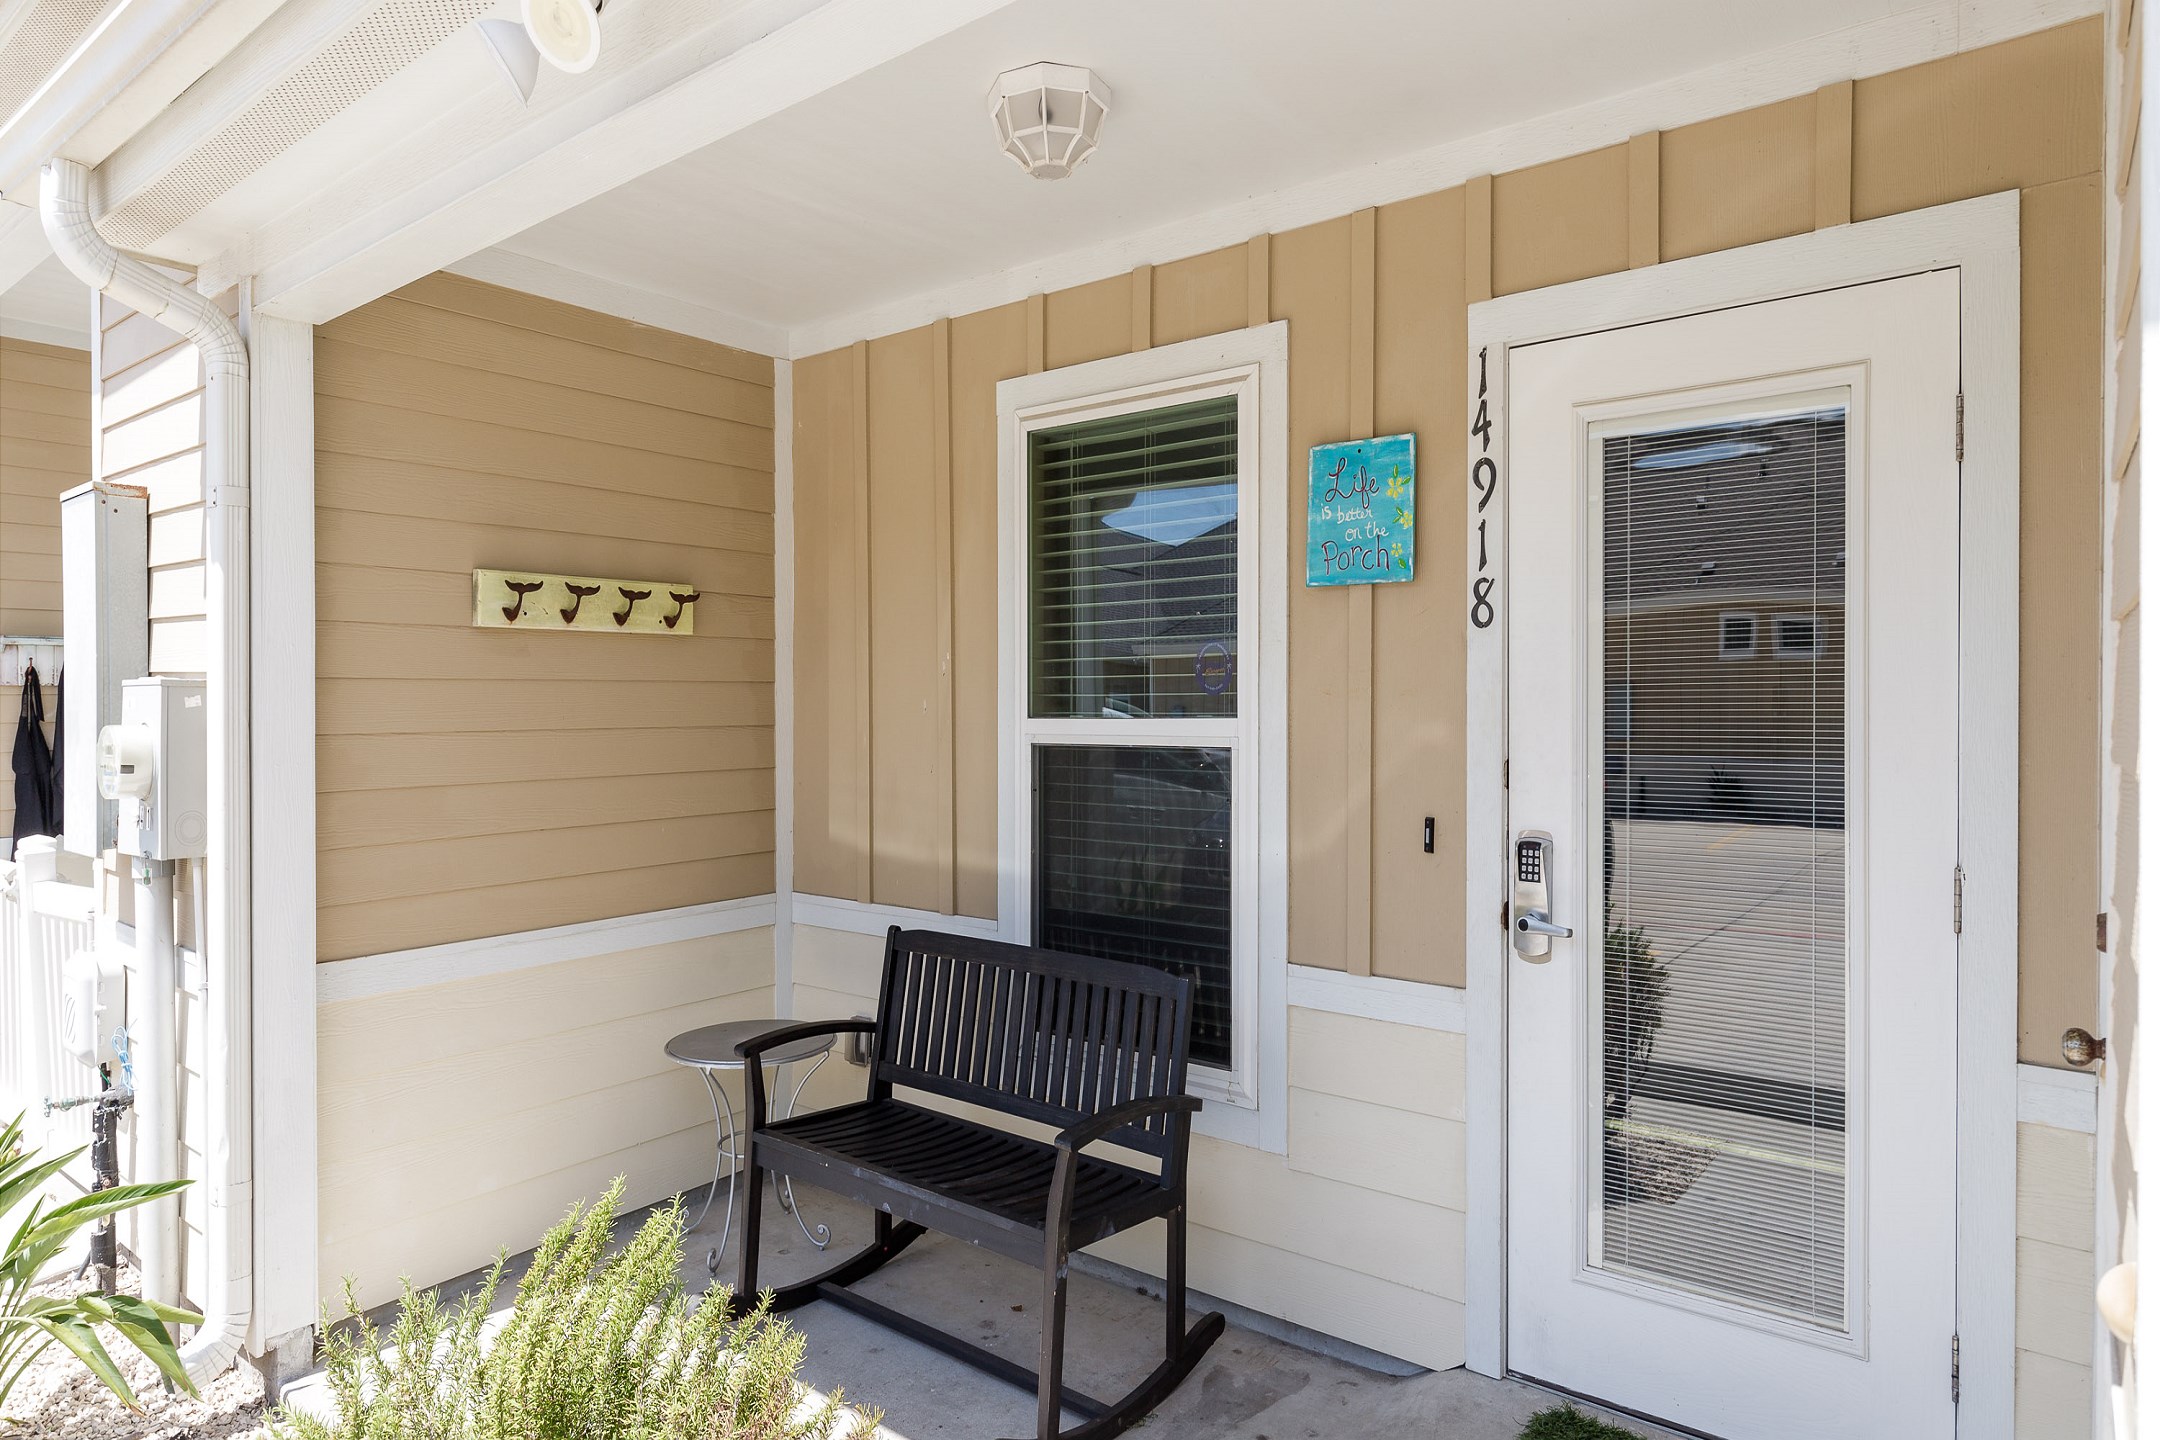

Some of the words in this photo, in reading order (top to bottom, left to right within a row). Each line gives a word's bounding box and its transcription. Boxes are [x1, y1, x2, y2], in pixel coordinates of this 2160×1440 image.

[1325, 457, 1380, 510] Life
[1471, 345, 1497, 629] 14918
[1321, 503, 1332, 520] is
[1337, 505, 1374, 525] better
[1345, 527, 1362, 541] on
[1365, 522, 1389, 538] the
[1321, 535, 1390, 576] Porch
